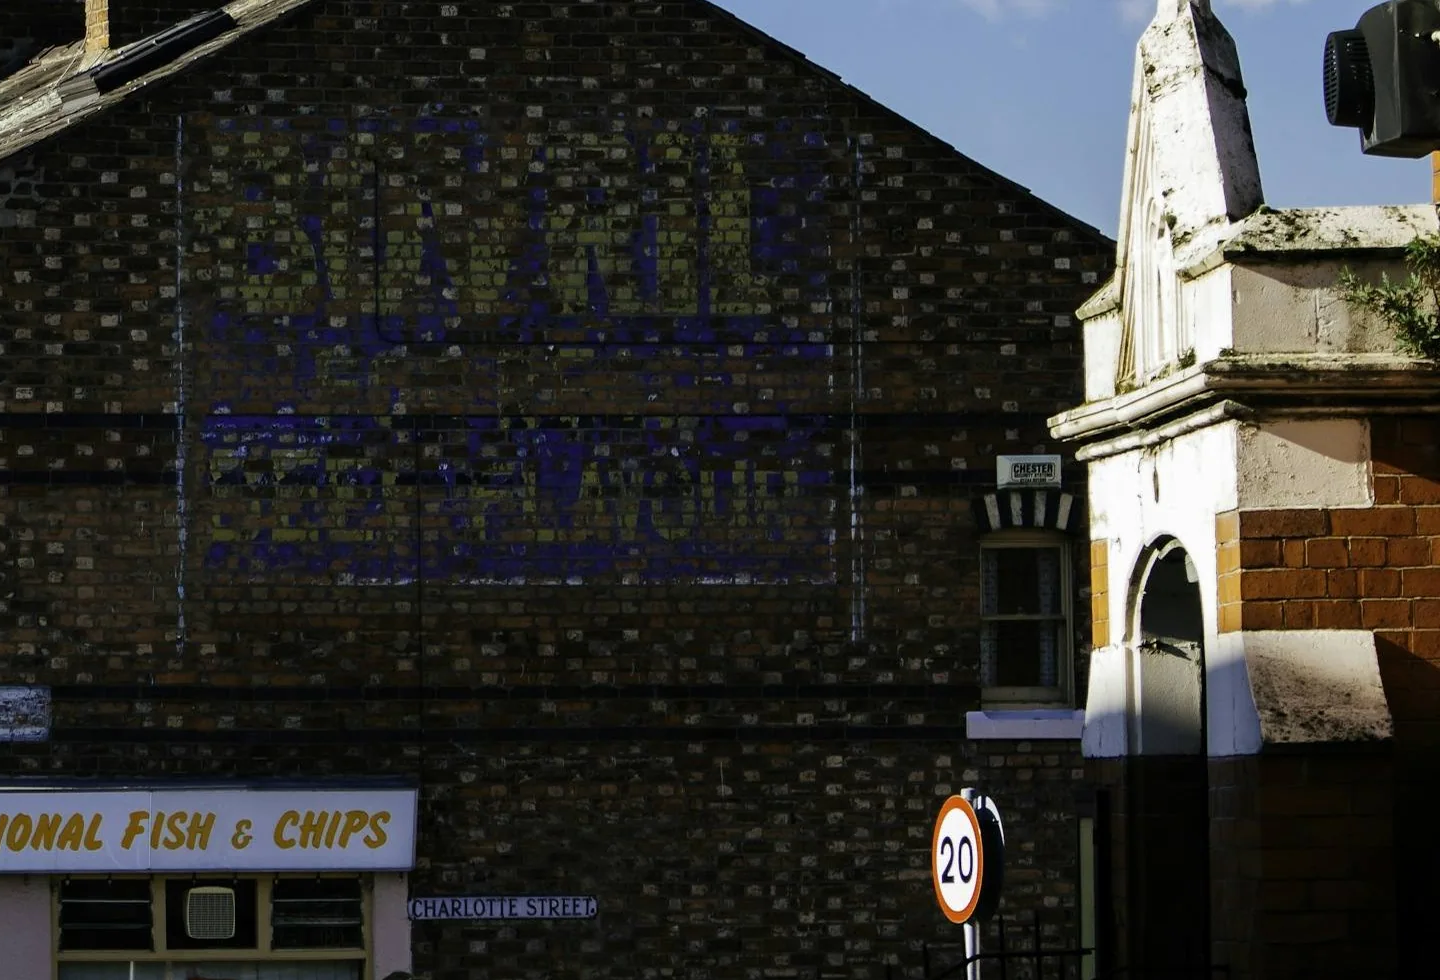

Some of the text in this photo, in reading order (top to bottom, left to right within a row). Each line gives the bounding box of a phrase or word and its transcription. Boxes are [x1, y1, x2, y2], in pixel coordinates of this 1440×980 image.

[1013, 463, 1053, 474] CHESTER
[121, 810, 216, 850] FISH
[231, 819, 253, 850] &
[273, 810, 391, 849] CHIPS
[940, 836, 973, 884] 20
[411, 899, 519, 918] CHARLOTTE
